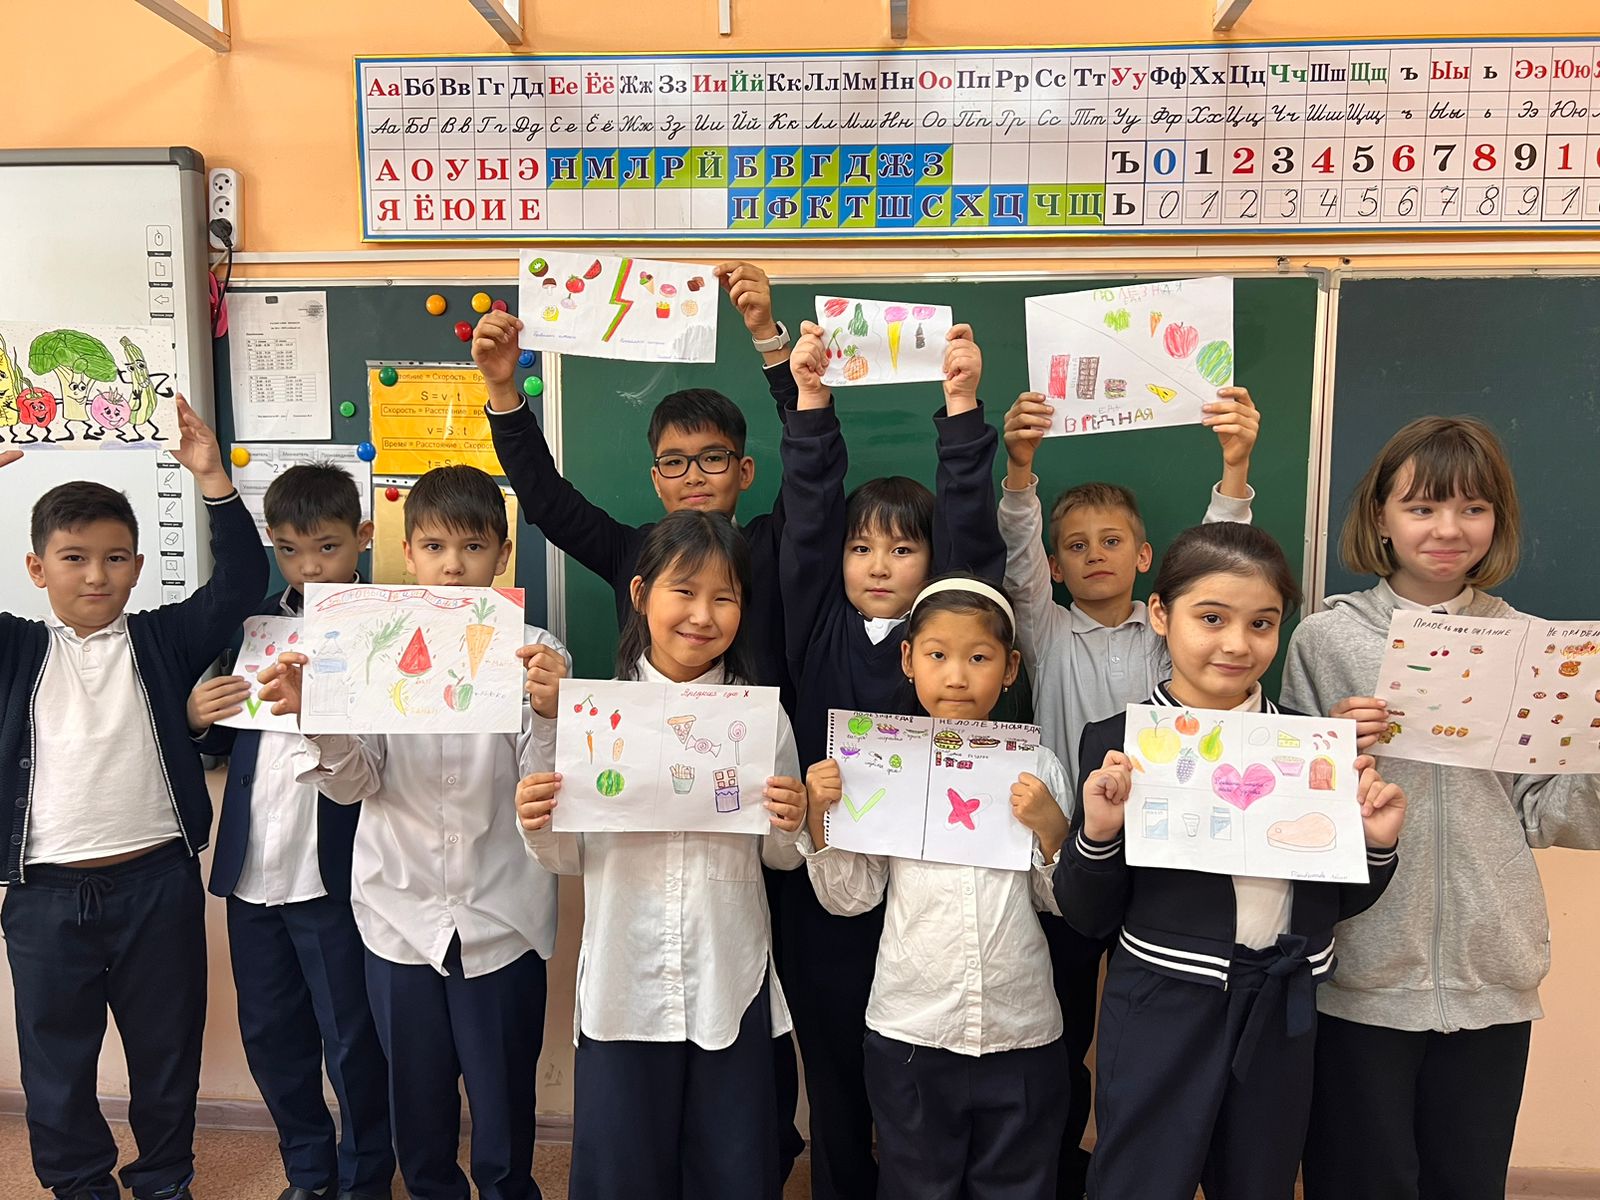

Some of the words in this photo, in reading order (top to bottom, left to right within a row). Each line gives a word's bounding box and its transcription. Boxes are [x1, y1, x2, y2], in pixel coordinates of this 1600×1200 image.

[369, 78, 401, 96] Аа
[404, 78, 435, 96] Бб
[439, 78, 471, 96] Вв
[477, 77, 505, 95] Гг
[511, 77, 544, 100] Дд
[548, 76, 578, 95] Ее
[585, 72, 615, 94] Ёё
[620, 75, 653, 94] Жж
[659, 75, 687, 94] Зз
[693, 74, 727, 92] Ии
[730, 70, 764, 92] Йй
[767, 73, 802, 92] Кк
[804, 73, 839, 91] Лл
[842, 72, 877, 90] Мм
[880, 71, 914, 90] Нн
[918, 71, 952, 90] Оо
[957, 70, 991, 89] Пп
[995, 70, 1029, 92] Рр
[1035, 69, 1066, 88] Сс
[1073, 68, 1106, 87] Тт
[1111, 67, 1147, 90] Уу
[1150, 66, 1187, 90] Фф
[1189, 66, 1226, 85] Хх
[1229, 65, 1266, 88] Цц
[1270, 64, 1307, 83] Чч
[1310, 63, 1346, 82] Шш
[1350, 62, 1387, 86] Щщ
[1431, 61, 1470, 80] Ыы
[1515, 59, 1547, 79] Ээ
[1553, 59, 1590, 79] Юю
[371, 117, 401, 134] Аа
[405, 117, 437, 134] Бб
[440, 117, 472, 133] Вв
[477, 116, 507, 133] Гг
[512, 116, 544, 142] Дд
[550, 116, 578, 133] Ее
[586, 114, 614, 132] Ёё
[620, 115, 654, 132] Жж
[660, 115, 686, 140] Зз
[694, 114, 725, 131] Ии
[732, 111, 761, 130] Йй
[768, 113, 799, 130] Кк
[805, 112, 837, 129] Лл
[841, 112, 877, 129] Мм
[879, 111, 914, 128] Нн
[922, 111, 947, 128] Оо
[955, 110, 991, 127] Пп
[996, 110, 1026, 136] Рр
[1038, 109, 1061, 126] Сс
[1070, 108, 1106, 126] Тт
[1113, 108, 1141, 134] Уу
[1150, 107, 1183, 133] Фф
[1188, 106, 1225, 124] Хх
[1228, 105, 1265, 127] Цц
[1271, 105, 1300, 122] Чч
[1307, 104, 1345, 121] Шш
[1347, 103, 1385, 125] Щщ
[1429, 101, 1465, 119] Ыы
[1518, 100, 1539, 118] Ээ
[1550, 100, 1587, 118] Юю
[375, 159, 400, 181] А
[411, 158, 433, 181] О
[445, 159, 470, 181] У
[477, 158, 509, 180] Ы
[518, 157, 539, 180] Э
[552, 158, 577, 180] Н
[587, 157, 615, 179] М
[624, 157, 649, 179] Л
[663, 157, 684, 179] Р
[697, 150, 722, 178] Й
[736, 156, 757, 178] Б
[773, 156, 794, 177] В
[811, 155, 831, 177] Г
[845, 155, 870, 182] Д
[879, 154, 912, 176] Ж
[924, 154, 943, 176] З
[1111, 151, 1140, 174] Ъ
[1153, 148, 1176, 175] 0
[1194, 148, 1213, 174] 1
[1232, 147, 1255, 174] 2
[1272, 146, 1294, 174] 3
[1311, 146, 1335, 173] 4
[1352, 145, 1374, 173] 5
[1392, 145, 1415, 172] 6
[1433, 144, 1457, 172] 7
[1473, 143, 1497, 171] 8
[1514, 143, 1537, 171] 9
[1557, 143, 1572, 170] 1
[377, 199, 401, 221] Я
[413, 194, 434, 221] Ё
[443, 198, 475, 221] Ю
[481, 199, 506, 221] И
[519, 199, 540, 221] Е
[734, 198, 759, 219] П
[769, 197, 797, 219] Ф
[808, 196, 832, 219] К
[846, 196, 868, 218] Т
[879, 196, 910, 217] Ш
[922, 195, 943, 218] С
[957, 195, 984, 217] Х
[995, 195, 1022, 221] Ц
[1034, 194, 1060, 216] Ч
[1068, 193, 1102, 221] Щ
[1112, 193, 1136, 216] Ь
[1159, 190, 1180, 219] 0
[1201, 190, 1219, 218] 1
[1239, 190, 1258, 218] 2
[1281, 189, 1298, 218] 3
[1320, 188, 1337, 217] 4
[1357, 185, 1378, 217] 5
[1398, 186, 1418, 216] 6
[1440, 185, 1459, 216] 7
[1476, 184, 1499, 216] 8
[1517, 186, 1539, 216] 9
[1561, 186, 1580, 215] 1
[421, 390, 428, 401] S
[457, 392, 461, 402] t
[463, 426, 467, 436] t
[273, 464, 279, 474] 2
